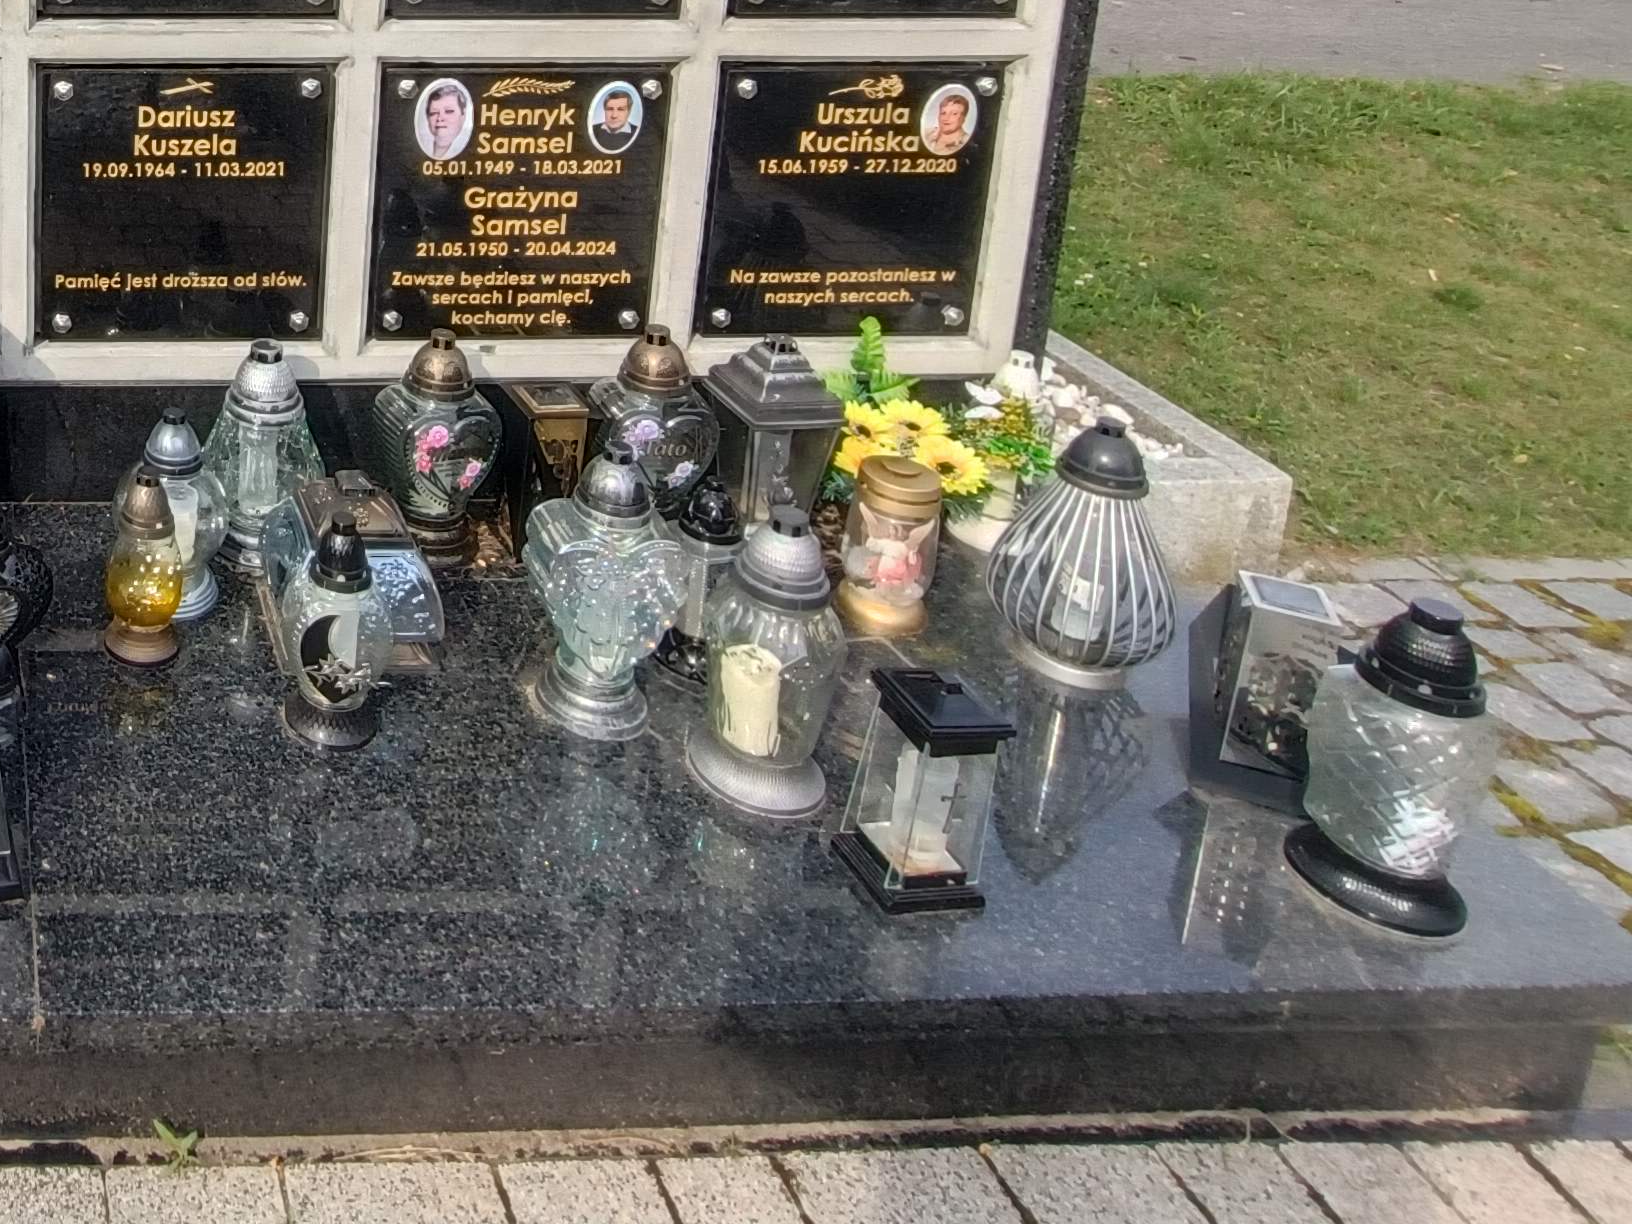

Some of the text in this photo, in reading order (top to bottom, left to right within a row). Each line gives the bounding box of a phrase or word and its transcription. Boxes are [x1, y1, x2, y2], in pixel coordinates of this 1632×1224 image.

[138, 105, 235, 127] Dariusz
[481, 103, 575, 130] Henryk
[818, 103, 909, 124] Urszula
[134, 134, 236, 156] Kuszela
[477, 132, 573, 154] Samsel
[800, 128, 920, 152] Kucińska
[83, 161, 284, 177] 19.09.1964 11.03.2021
[423, 160, 621, 175] 05.01.1949 18.03.2021
[759, 159, 956, 173] 15.06.1959 27.12.2020
[465, 186, 577, 212] Grażyna
[471, 214, 566, 235] Samsel
[416, 241, 616, 256] 21.05.1950 20.04.2024
[56, 271, 306, 291] Pamięć jest droższa od słów.
[392, 270, 631, 288] Zawsze będziesz w naszych
[432, 290, 502, 304] sercach
[517, 289, 593, 307] pamięci,
[452, 310, 570, 327] kochamy cię.
